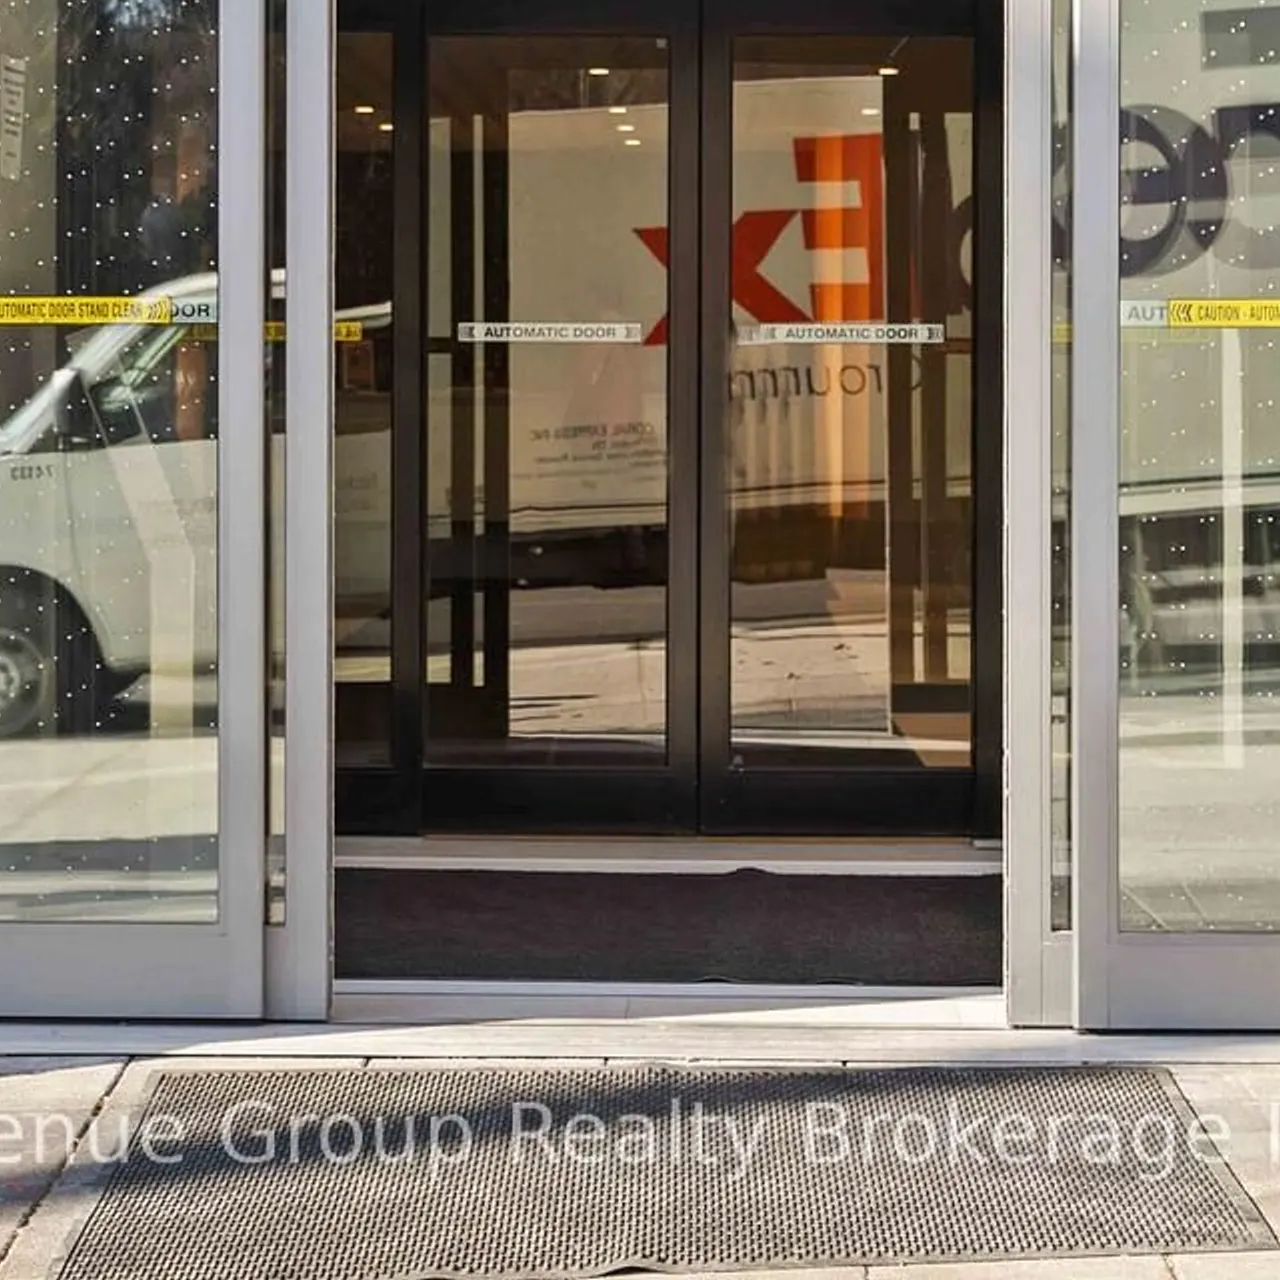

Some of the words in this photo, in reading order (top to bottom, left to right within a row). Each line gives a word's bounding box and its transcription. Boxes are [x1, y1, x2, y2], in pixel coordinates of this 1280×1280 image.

[48, 303, 75, 318] DOOR
[78, 303, 110, 318] STAND
[1197, 304, 1240, 321] CAUTION
[484, 326, 569, 338] AUTOMATIC
[573, 326, 616, 337] DOOR
[785, 327, 871, 340] AUTOMATIC
[875, 327, 918, 339] DOOR
